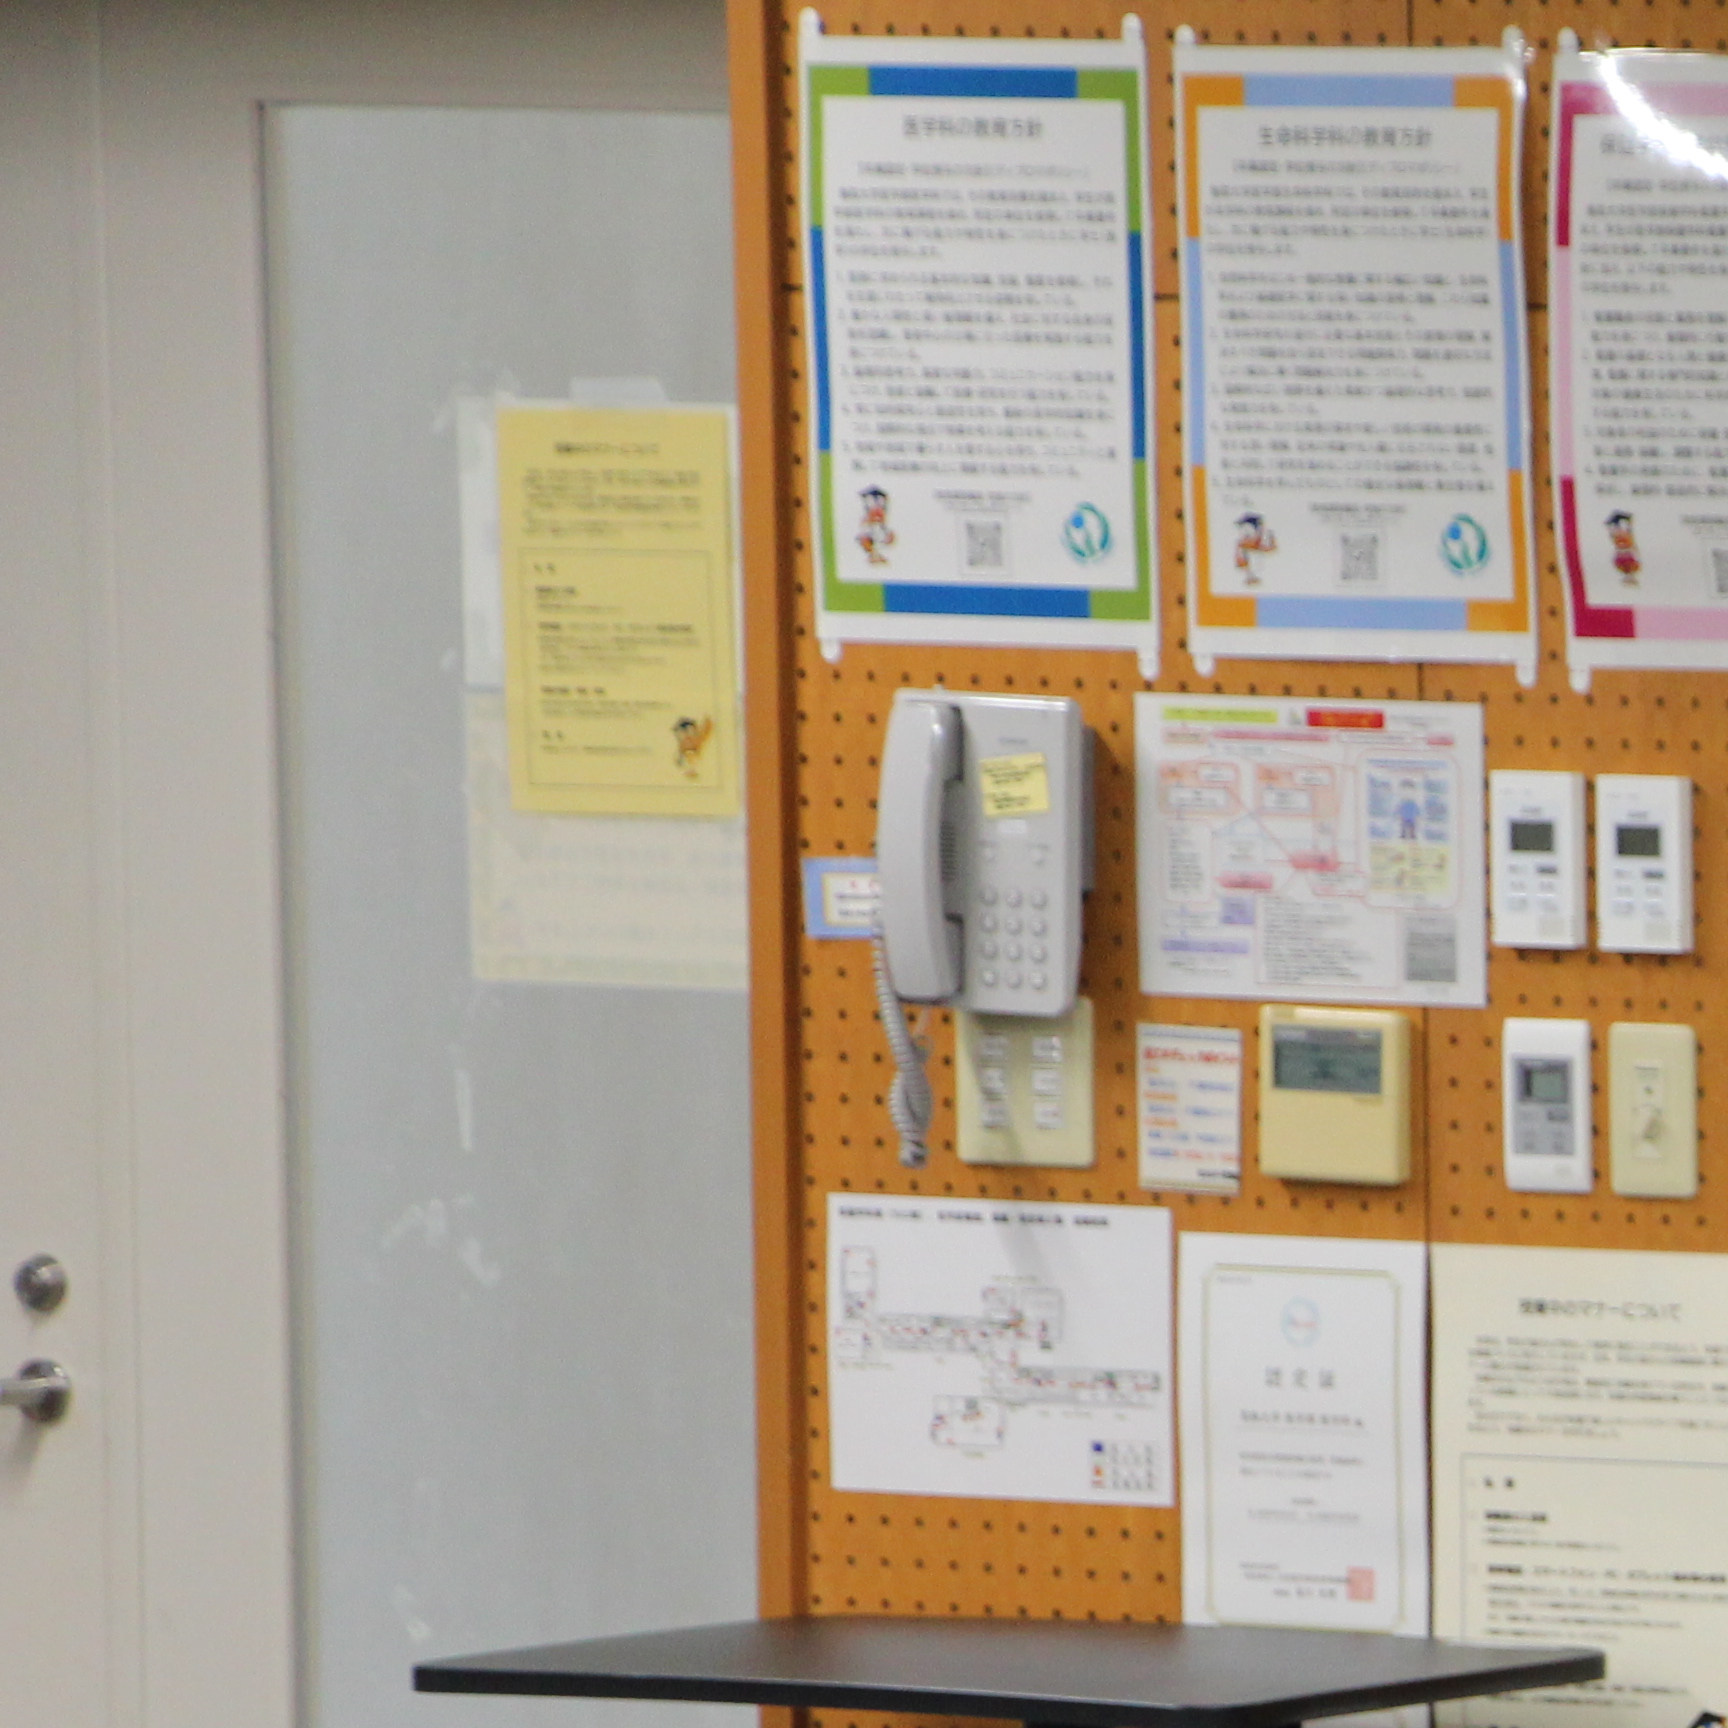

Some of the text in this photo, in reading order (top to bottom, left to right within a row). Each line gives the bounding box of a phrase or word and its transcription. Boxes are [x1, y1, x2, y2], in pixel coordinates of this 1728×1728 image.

[904, 113, 1042, 137] 医学科の教育方針
[1259, 124, 1432, 147] 生命科学科の教育方針
